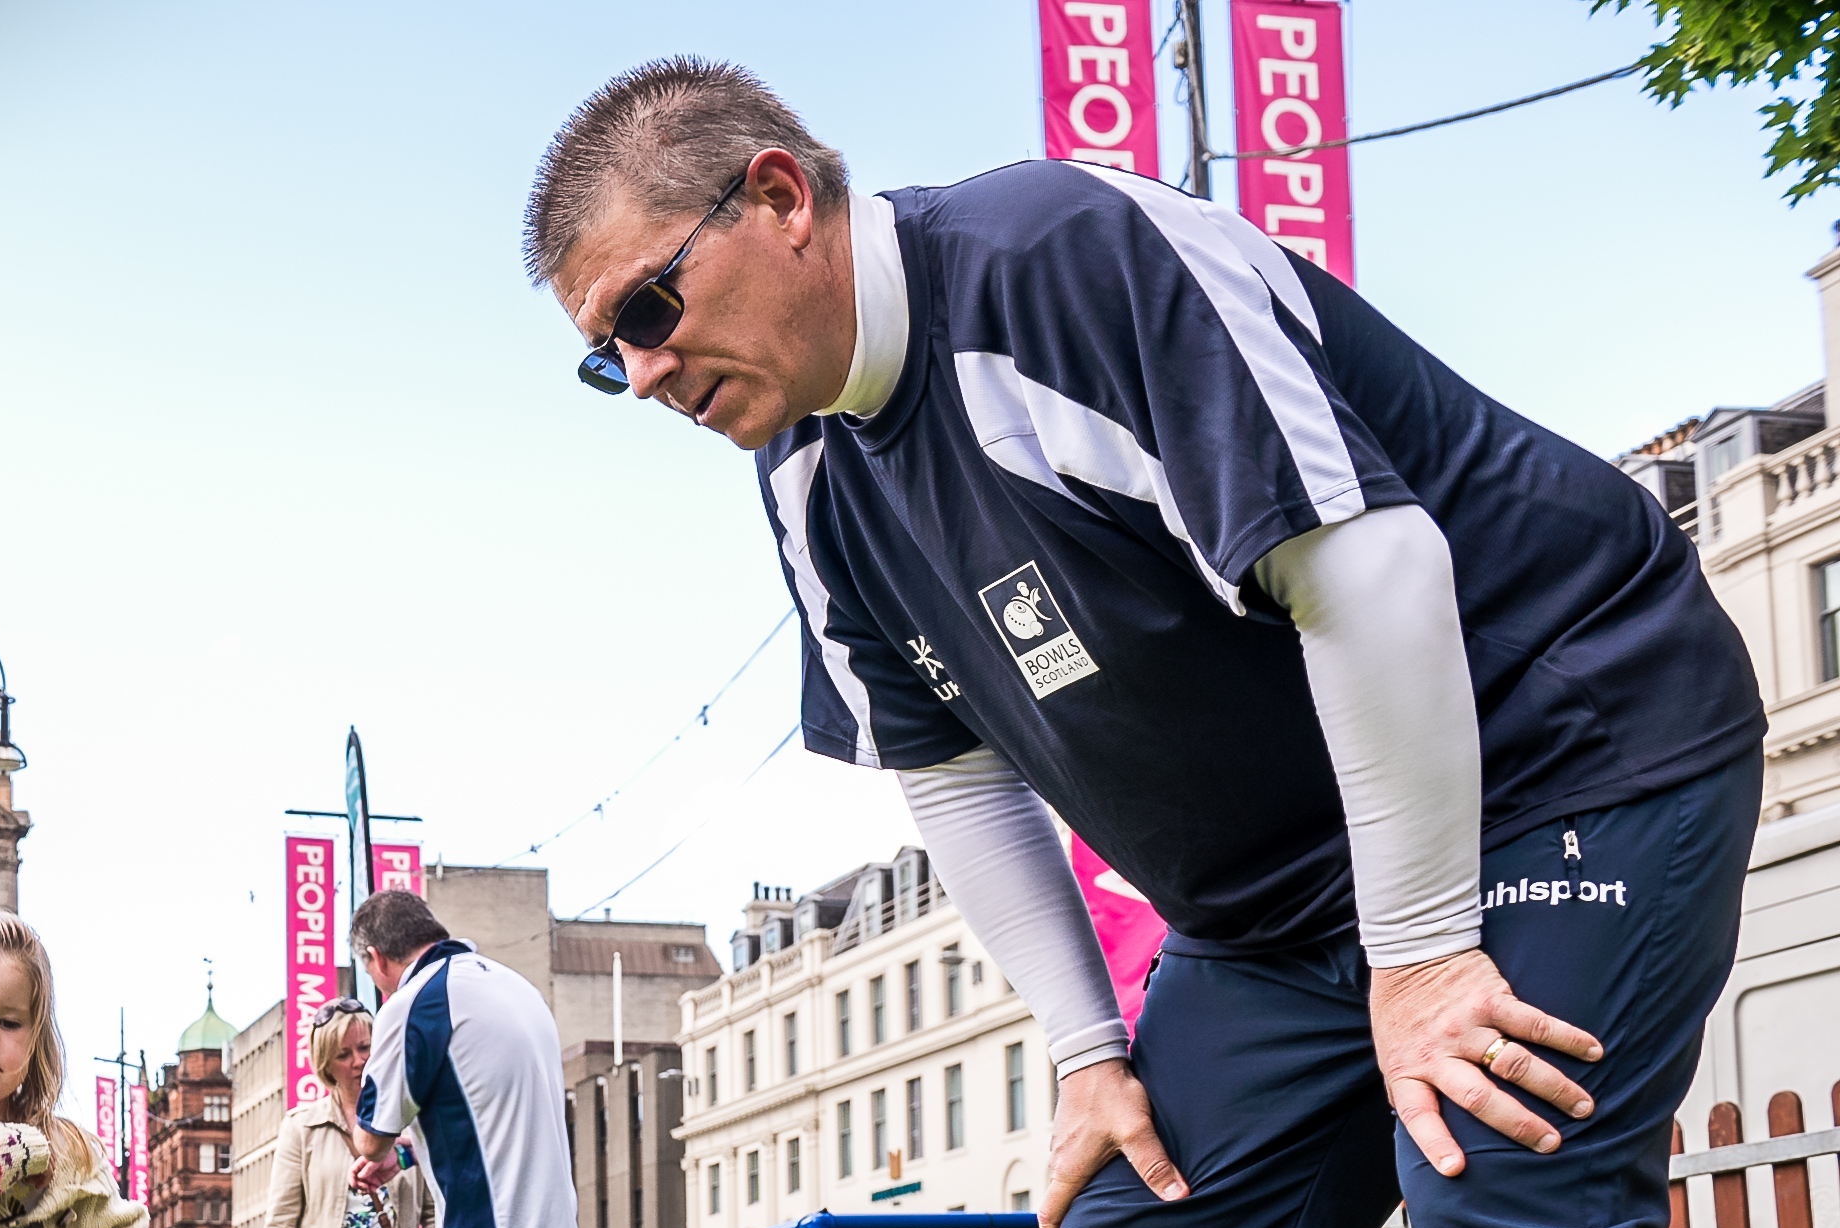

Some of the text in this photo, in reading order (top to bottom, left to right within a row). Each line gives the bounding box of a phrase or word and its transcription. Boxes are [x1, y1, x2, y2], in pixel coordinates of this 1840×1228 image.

[1025, 638, 1081, 676] BOWLS
[1035, 656, 1089, 689] SCOTLAND
[296, 844, 326, 966] PEOPLE
[1479, 877, 1627, 911] uhlsport
